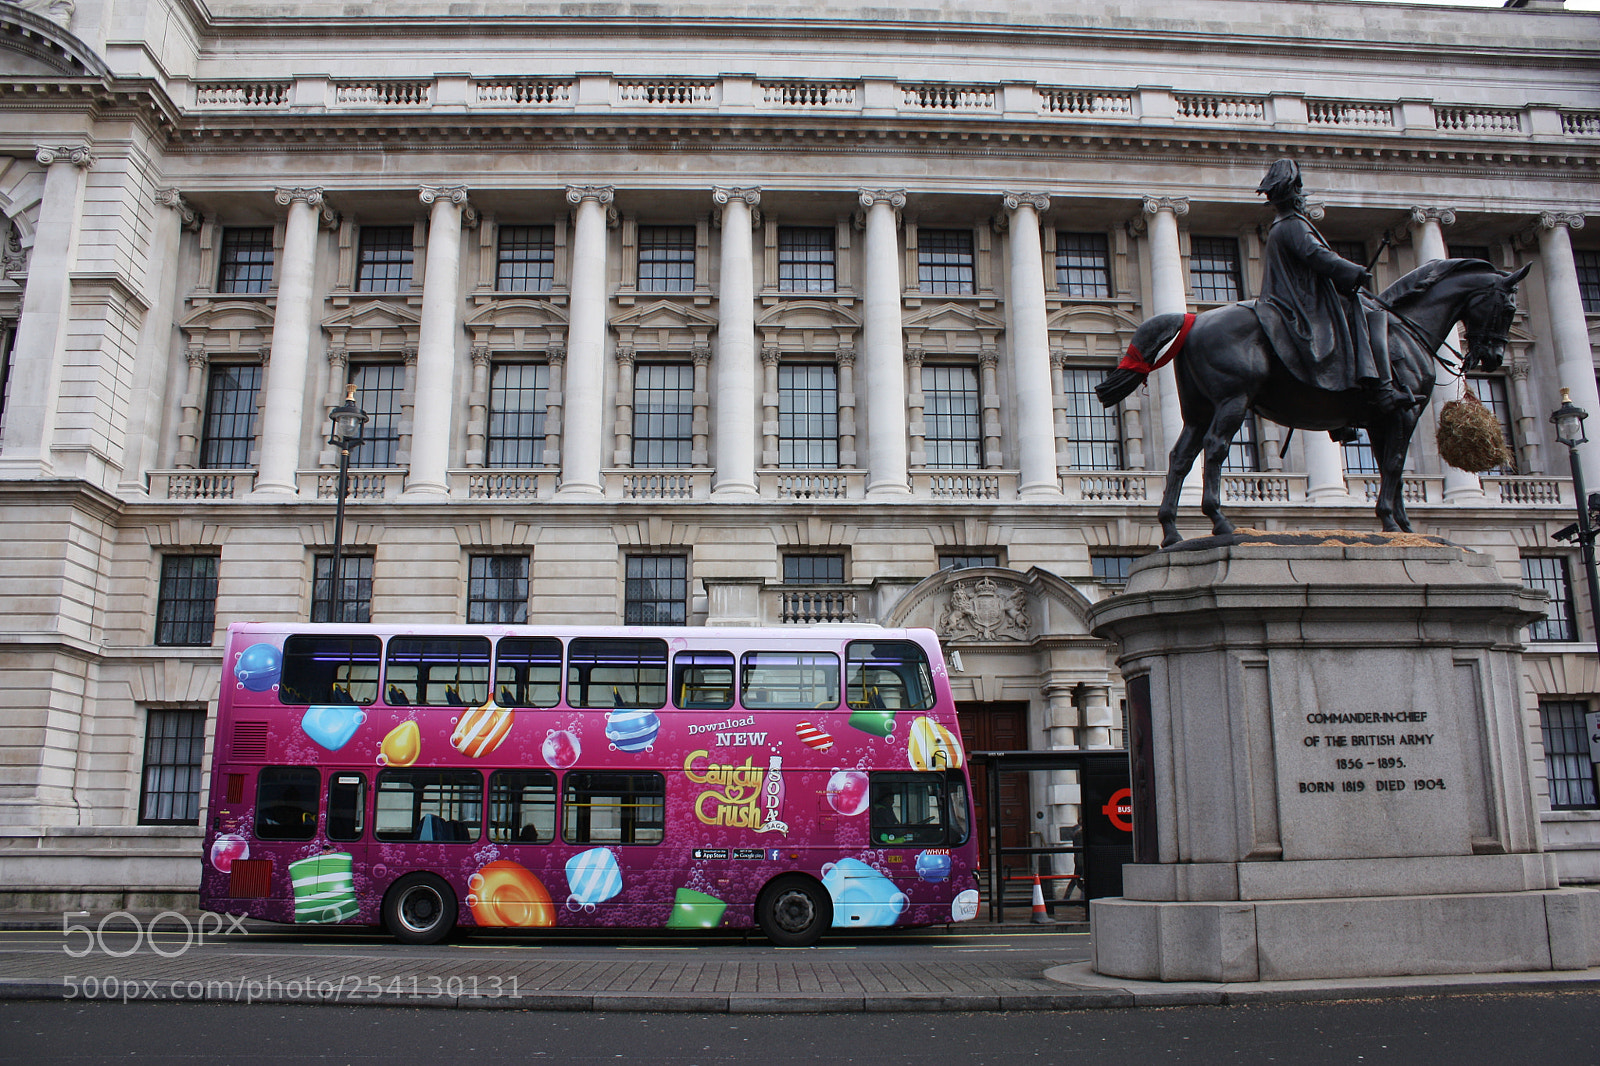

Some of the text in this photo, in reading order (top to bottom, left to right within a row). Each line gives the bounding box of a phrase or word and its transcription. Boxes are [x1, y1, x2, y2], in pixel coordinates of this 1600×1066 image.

[688, 715, 755, 735] Download
[1306, 712, 1428, 724] COMMANDER-IN-CHIEF
[715, 732, 768, 747] NEW
[1303, 734, 1435, 747] OF THE BRITISH ARMY
[1336, 758, 1363, 769] 1856
[683, 749, 764, 795] Candy
[1299, 781, 1335, 793] BORN
[1341, 780, 1366, 792] 1819
[1376, 779, 1406, 791] DIED
[764, 767, 780, 822] SODA
[694, 790, 762, 829] Crush
[765, 822, 786, 831] SAGA
